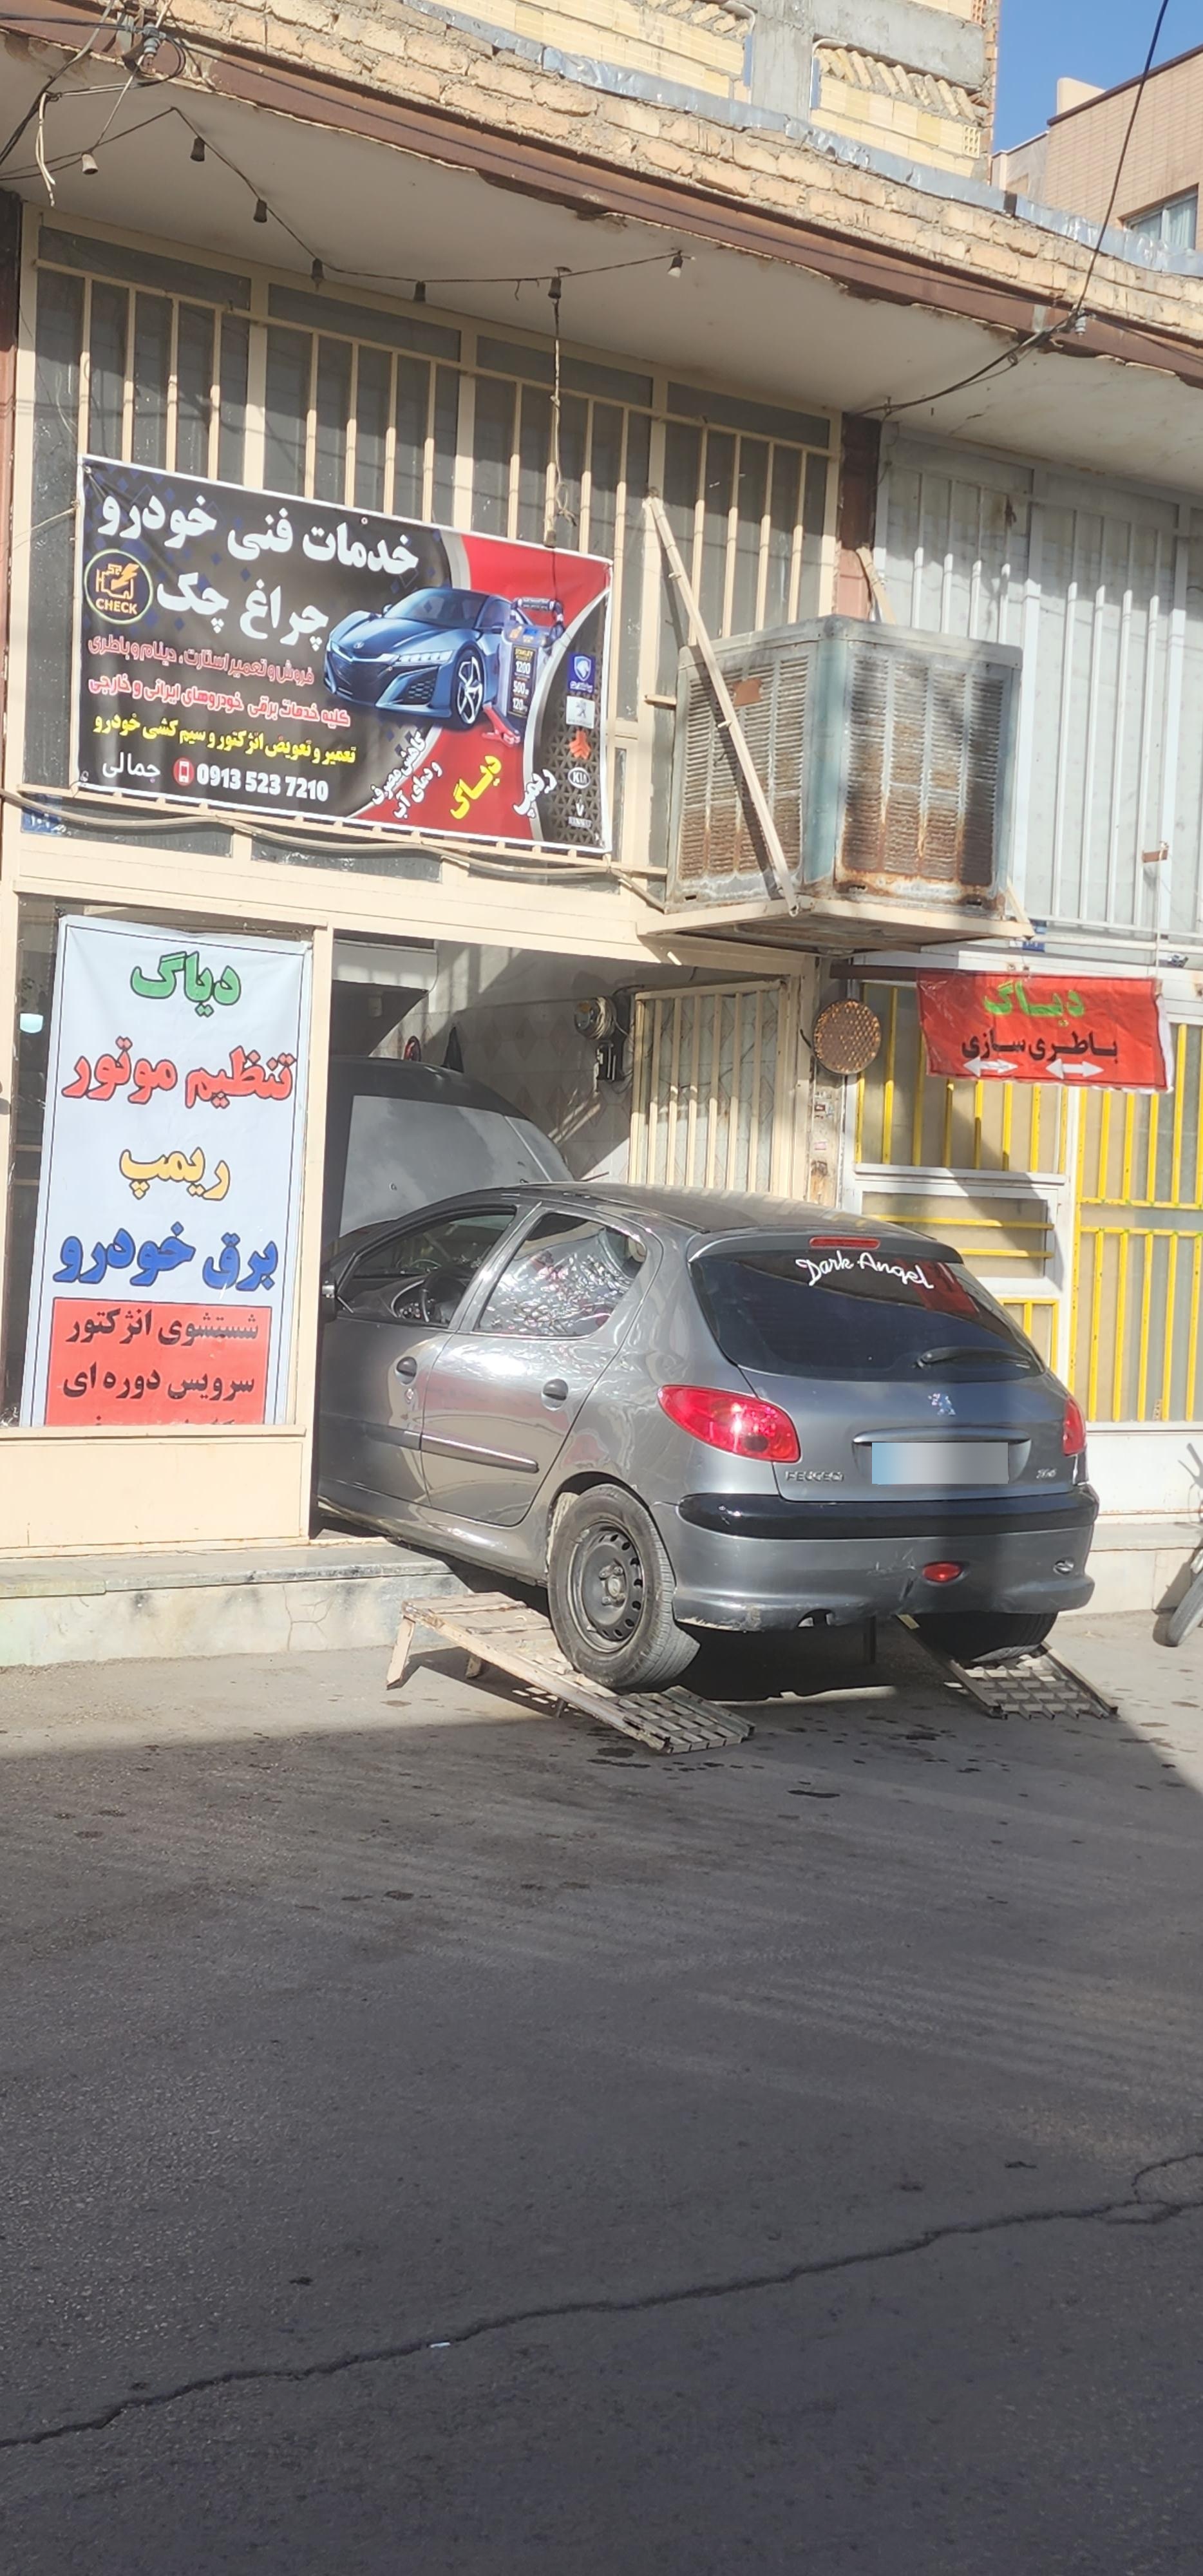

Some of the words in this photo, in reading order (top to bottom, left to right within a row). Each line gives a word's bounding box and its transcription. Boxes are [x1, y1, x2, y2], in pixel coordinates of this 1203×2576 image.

[97, 495, 217, 548] خودرو
[227, 507, 294, 560] فنی
[303, 522, 419, 574] خدمات
[95, 598, 138, 615] CHECK
[156, 572, 229, 634] چک
[240, 579, 329, 652] چراغ
[88, 634, 130, 660] باطری
[131, 642, 140, 661] و
[140, 641, 177, 666] دینام
[228, 658, 268, 677] تعمیر
[267, 665, 276, 681] و
[277, 659, 314, 686] فروش
[88, 673, 131, 696] خارجی
[132, 680, 143, 699] و
[144, 678, 181, 705] ایرانی
[181, 685, 245, 714] خودروهای
[93, 712, 141, 736] خودرو
[247, 696, 279, 721] برقی
[279, 698, 320, 721] خدمات
[321, 708, 351, 728] کلیه
[142, 717, 179, 739] کشی
[179, 729, 206, 744] سیم
[207, 732, 216, 748] و
[265, 735, 312, 761] تعویض
[312, 747, 321, 764] و
[322, 746, 356, 764] تعمیر
[401, 730, 426, 777] کاهش
[102, 752, 161, 784] جمالی
[196, 763, 242, 790] 0913
[245, 771, 281, 796] 523
[285, 776, 329, 802] 7210
[370, 768, 403, 806] مصرف
[450, 755, 502, 820] دیاگ
[393, 789, 412, 820] آب
[130, 951, 242, 1018] دیاگ
[983, 979, 1086, 1027] دیاگ
[961, 1027, 1026, 1059] سازی
[1028, 1030, 1118, 1063] باطری
[61, 1036, 178, 1104] موتور
[185, 1045, 298, 1109] تنظیم
[119, 1146, 231, 1201] ریمپ
[53, 1221, 196, 1287] خودرو
[202, 1232, 279, 1292] برق
[795, 1250, 855, 1286] Dark
[857, 1252, 934, 1289] Angel
[65, 1307, 153, 1344] انژکتور
[158, 1312, 258, 1346] شستشوی
[167, 1373, 255, 1401] سرویس
